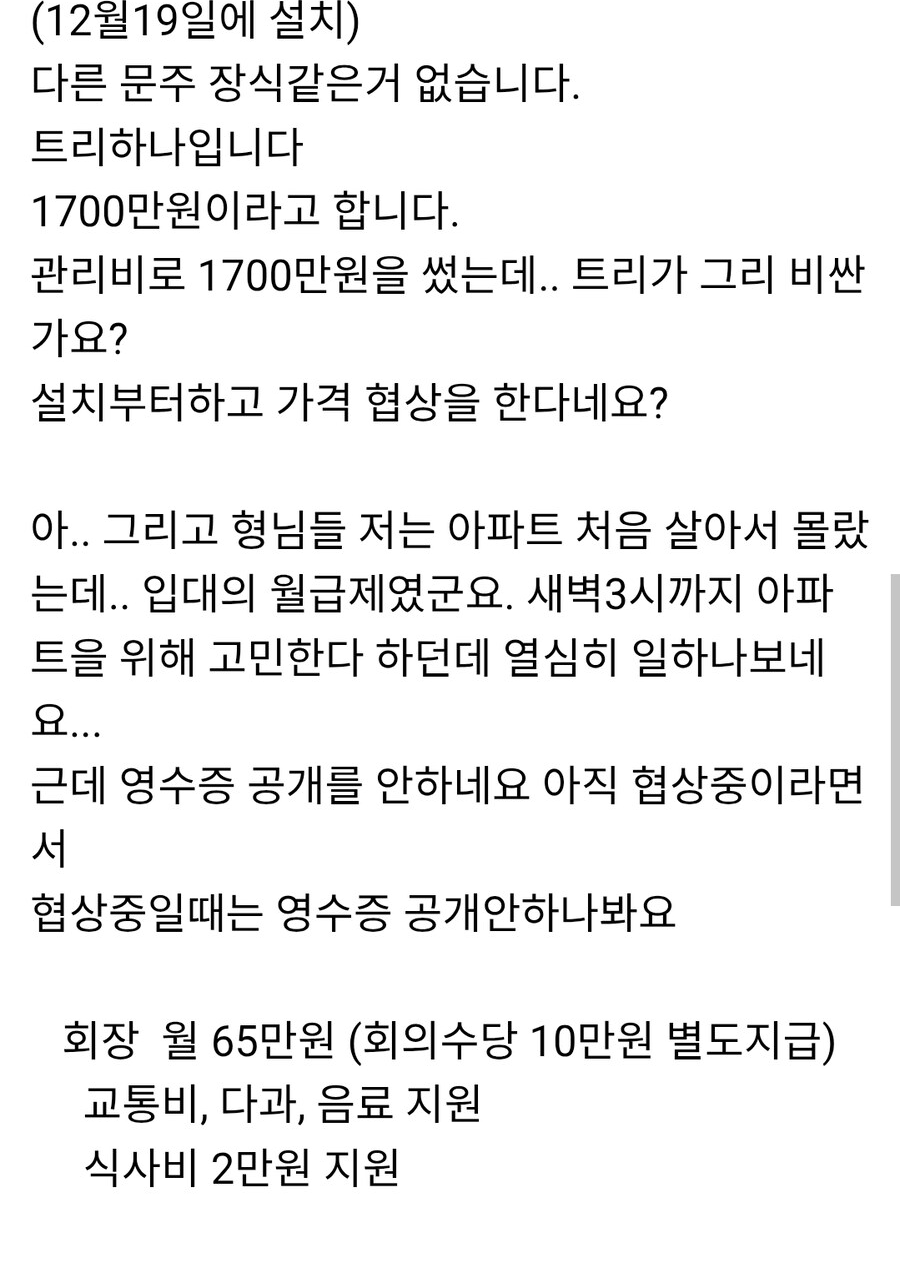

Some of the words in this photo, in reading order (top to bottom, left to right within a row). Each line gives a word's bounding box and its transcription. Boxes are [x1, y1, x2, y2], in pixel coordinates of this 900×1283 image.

[32, 0, 255, 46] (12월19일에
[269, 0, 359, 46] 설치)
[33, 62, 107, 103] 다른
[120, 64, 196, 103] 문주
[209, 62, 399, 103] 장식같은거
[415, 62, 579, 103] 없습니다.
[31, 127, 304, 167] 트리하나입니다
[32, 190, 320, 231] 1700만원이라고
[333, 190, 458, 231] 합니다.
[31, 254, 186, 295] 관리비로
[199, 254, 409, 295] 1700만원을
[422, 254, 558, 295] 썼는데..
[572, 254, 688, 295] 트리가
[700, 254, 773, 295] 그리
[791, 254, 866, 295] 비싼
[31, 318, 128, 358] 가요?
[31, 382, 264, 423] 설치부터하고
[277, 382, 349, 423] 가격
[365, 382, 480, 423] 협상을
[493, 382, 668, 423] 한다네요?
[32, 509, 89, 550] 아..
[103, 509, 218, 550] 그리고
[231, 509, 346, 550] 형님들
[359, 509, 435, 550] 저는
[448, 509, 563, 550] 아파트
[576, 509, 652, 550] 처음
[665, 509, 777, 550] 살아서
[793, 509, 870, 550] 몰랐
[31, 573, 128, 614] 는데..
[143, 573, 254, 614] 입대의
[270, 573, 513, 614] 월급제였군요.
[527, 573, 741, 614] 새벽3시까지
[757, 573, 834, 614] 아파
[31, 638, 107, 678] 트을
[120, 637, 194, 678] 위해
[209, 637, 364, 678] 고민한다
[375, 637, 489, 678] 하던데
[504, 637, 616, 678] 열심히
[633, 637, 823, 678] 일하나보네
[31, 703, 100, 738] 요...
[31, 765, 105, 805] 근데
[120, 765, 235, 805] 영수증
[248, 765, 363, 805] 공개를
[377, 765, 530, 805] 안하네요
[543, 765, 616, 805] 아직
[632, 765, 863, 805] 협상중이라면
[31, 828, 65, 869] 서
[31, 892, 264, 933] 협상중일때는
[277, 892, 392, 933] 영수증
[404, 892, 676, 933] 공개안하나봐요
[63, 1020, 140, 1061] 회장
[162, 1020, 197, 1061] 월
[212, 1020, 334, 1060] 65만원
[349, 1020, 518, 1067] (회의수당
[531, 1020, 652, 1060] 10만원
[668, 1020, 835, 1067] 별도지급)
[84, 1083, 208, 1126] 교통비,
[222, 1083, 305, 1126] 다과,
[317, 1084, 394, 1124] 음료
[407, 1083, 480, 1124] 지원
[84, 1147, 196, 1188] 식사비
[212, 1147, 310, 1187] 2만원
[325, 1148, 398, 1188] 지원
